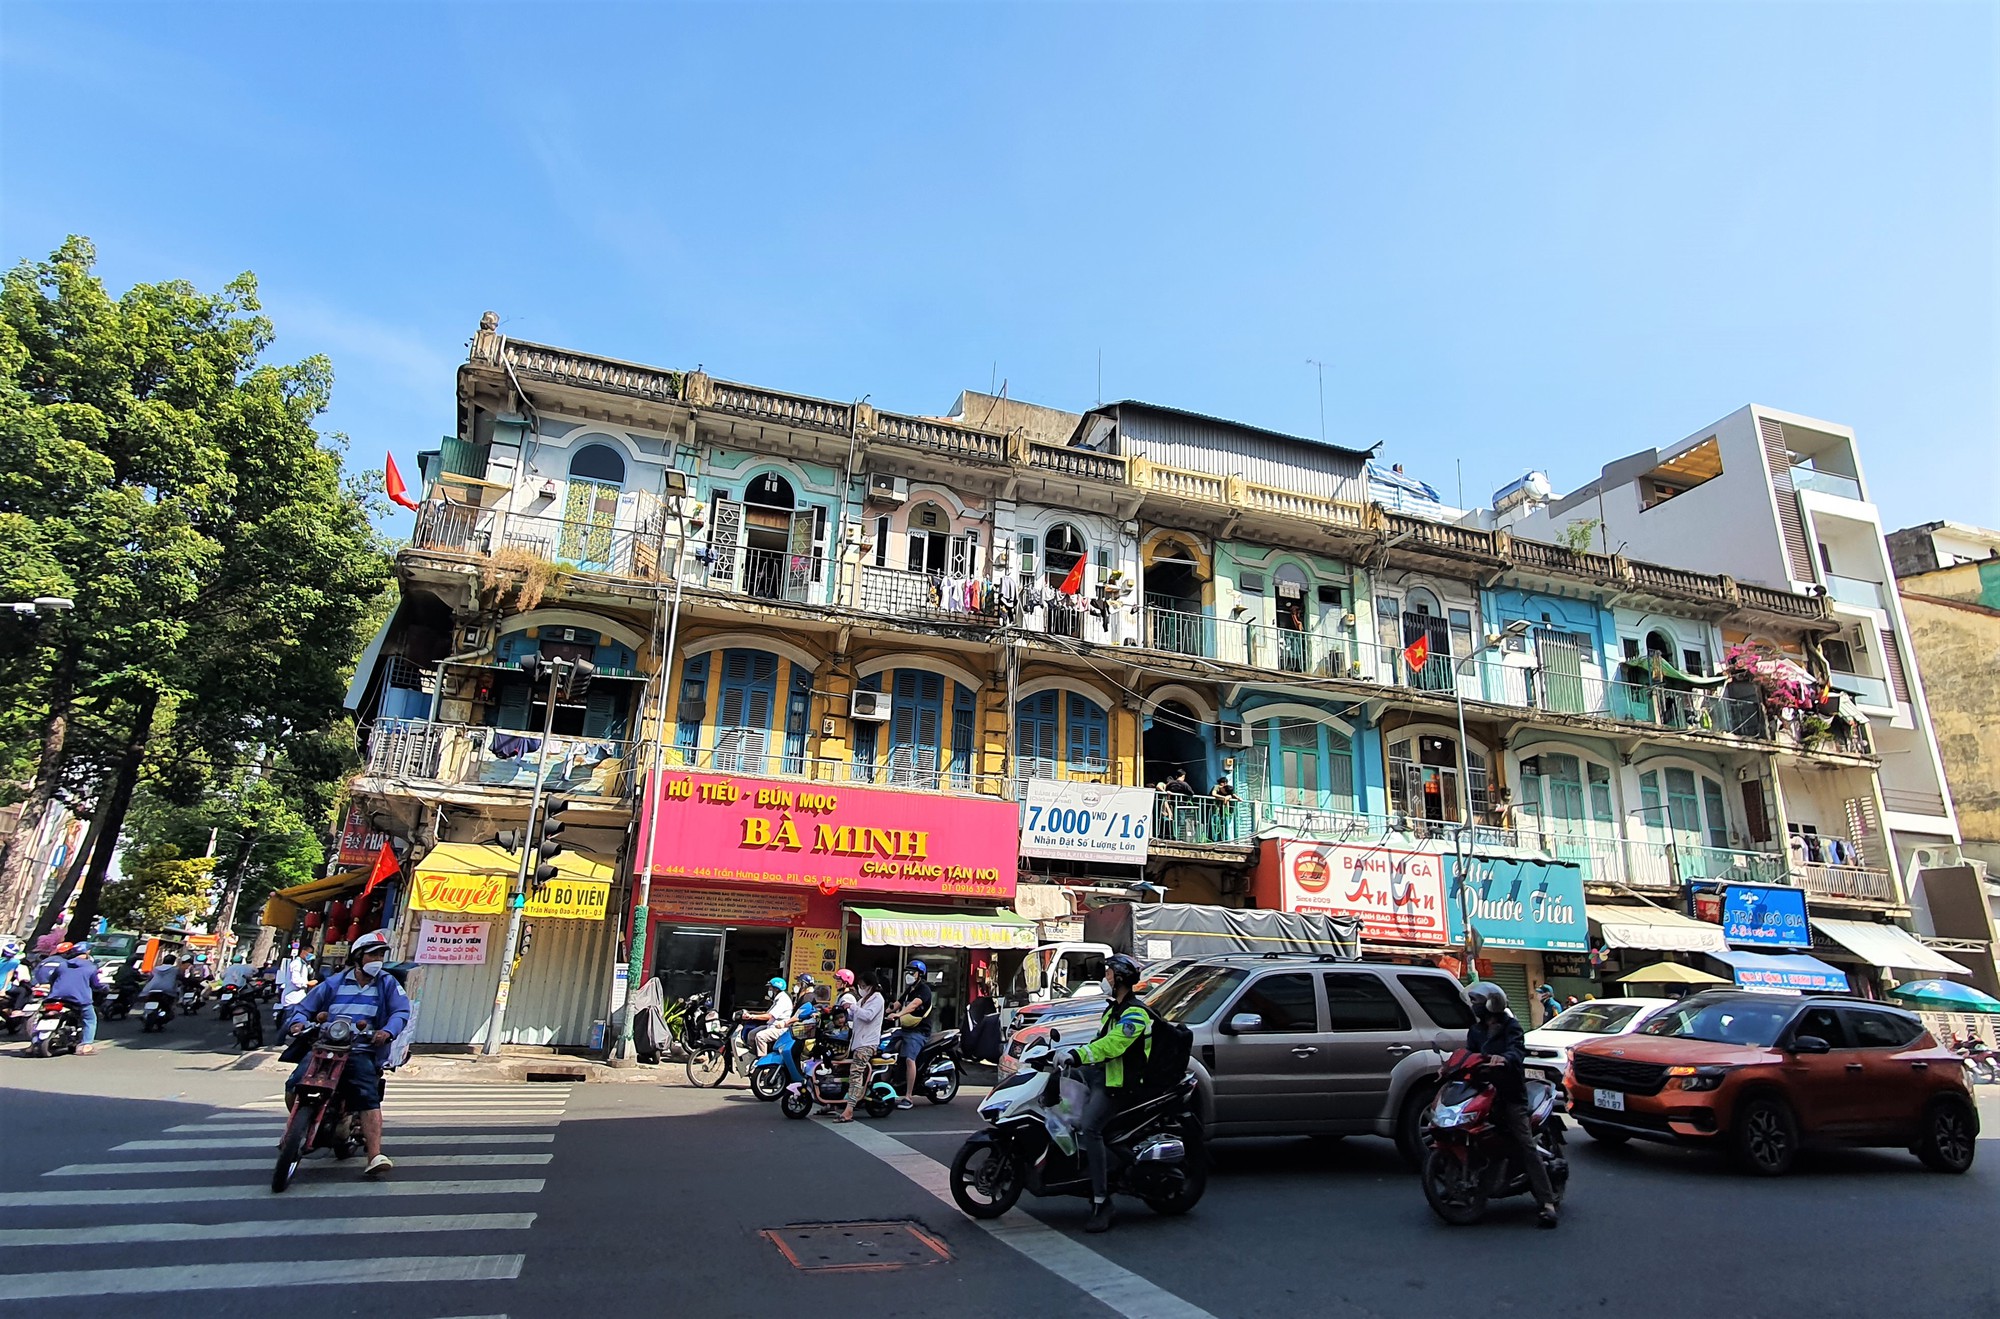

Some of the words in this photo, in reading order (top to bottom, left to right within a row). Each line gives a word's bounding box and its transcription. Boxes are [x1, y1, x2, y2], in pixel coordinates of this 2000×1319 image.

[668, 775, 694, 798] HỦ
[700, 779, 739, 803] TIẾU
[757, 786, 793, 807] BÚN
[799, 792, 838, 813] MỌC
[1028, 805, 1091, 835] 7.000
[742, 811, 803, 848] BÀ
[815, 822, 929, 858] MINH
[1034, 835, 1057, 846] Nhận
[1059, 837, 1075, 848] Đặt
[1077, 837, 1089, 848] Số
[1091, 839, 1117, 851] Lượng
[1120, 841, 1136, 851] Lớn
[666, 865, 685, 874] 444
[693, 867, 711, 876] 446
[713, 868, 734, 878] Trần
[735, 870, 760, 882] Hưng
[836, 877, 857, 887] HCM
[863, 861, 900, 875] GIAO
[903, 861, 942, 877] HÀNG
[947, 863, 972, 881] TẬN
[1343, 854, 1386, 873] BÁNH
[1411, 860, 1432, 877] GÀ
[421, 874, 501, 911] Tuyết
[554, 884, 573, 905] BÒ
[577, 886, 605, 906] VIÊN
[955, 884, 974, 893] 0916
[976, 885, 986, 894] 37
[987, 886, 997, 894] 28
[998, 887, 1007, 895] 37
[1344, 878, 1388, 907] An
[1393, 881, 1435, 911] An
[1530, 889, 1576, 925] Tiến
[433, 923, 480, 935] TUYẾT
[1784, 913, 1806, 928] GIA
